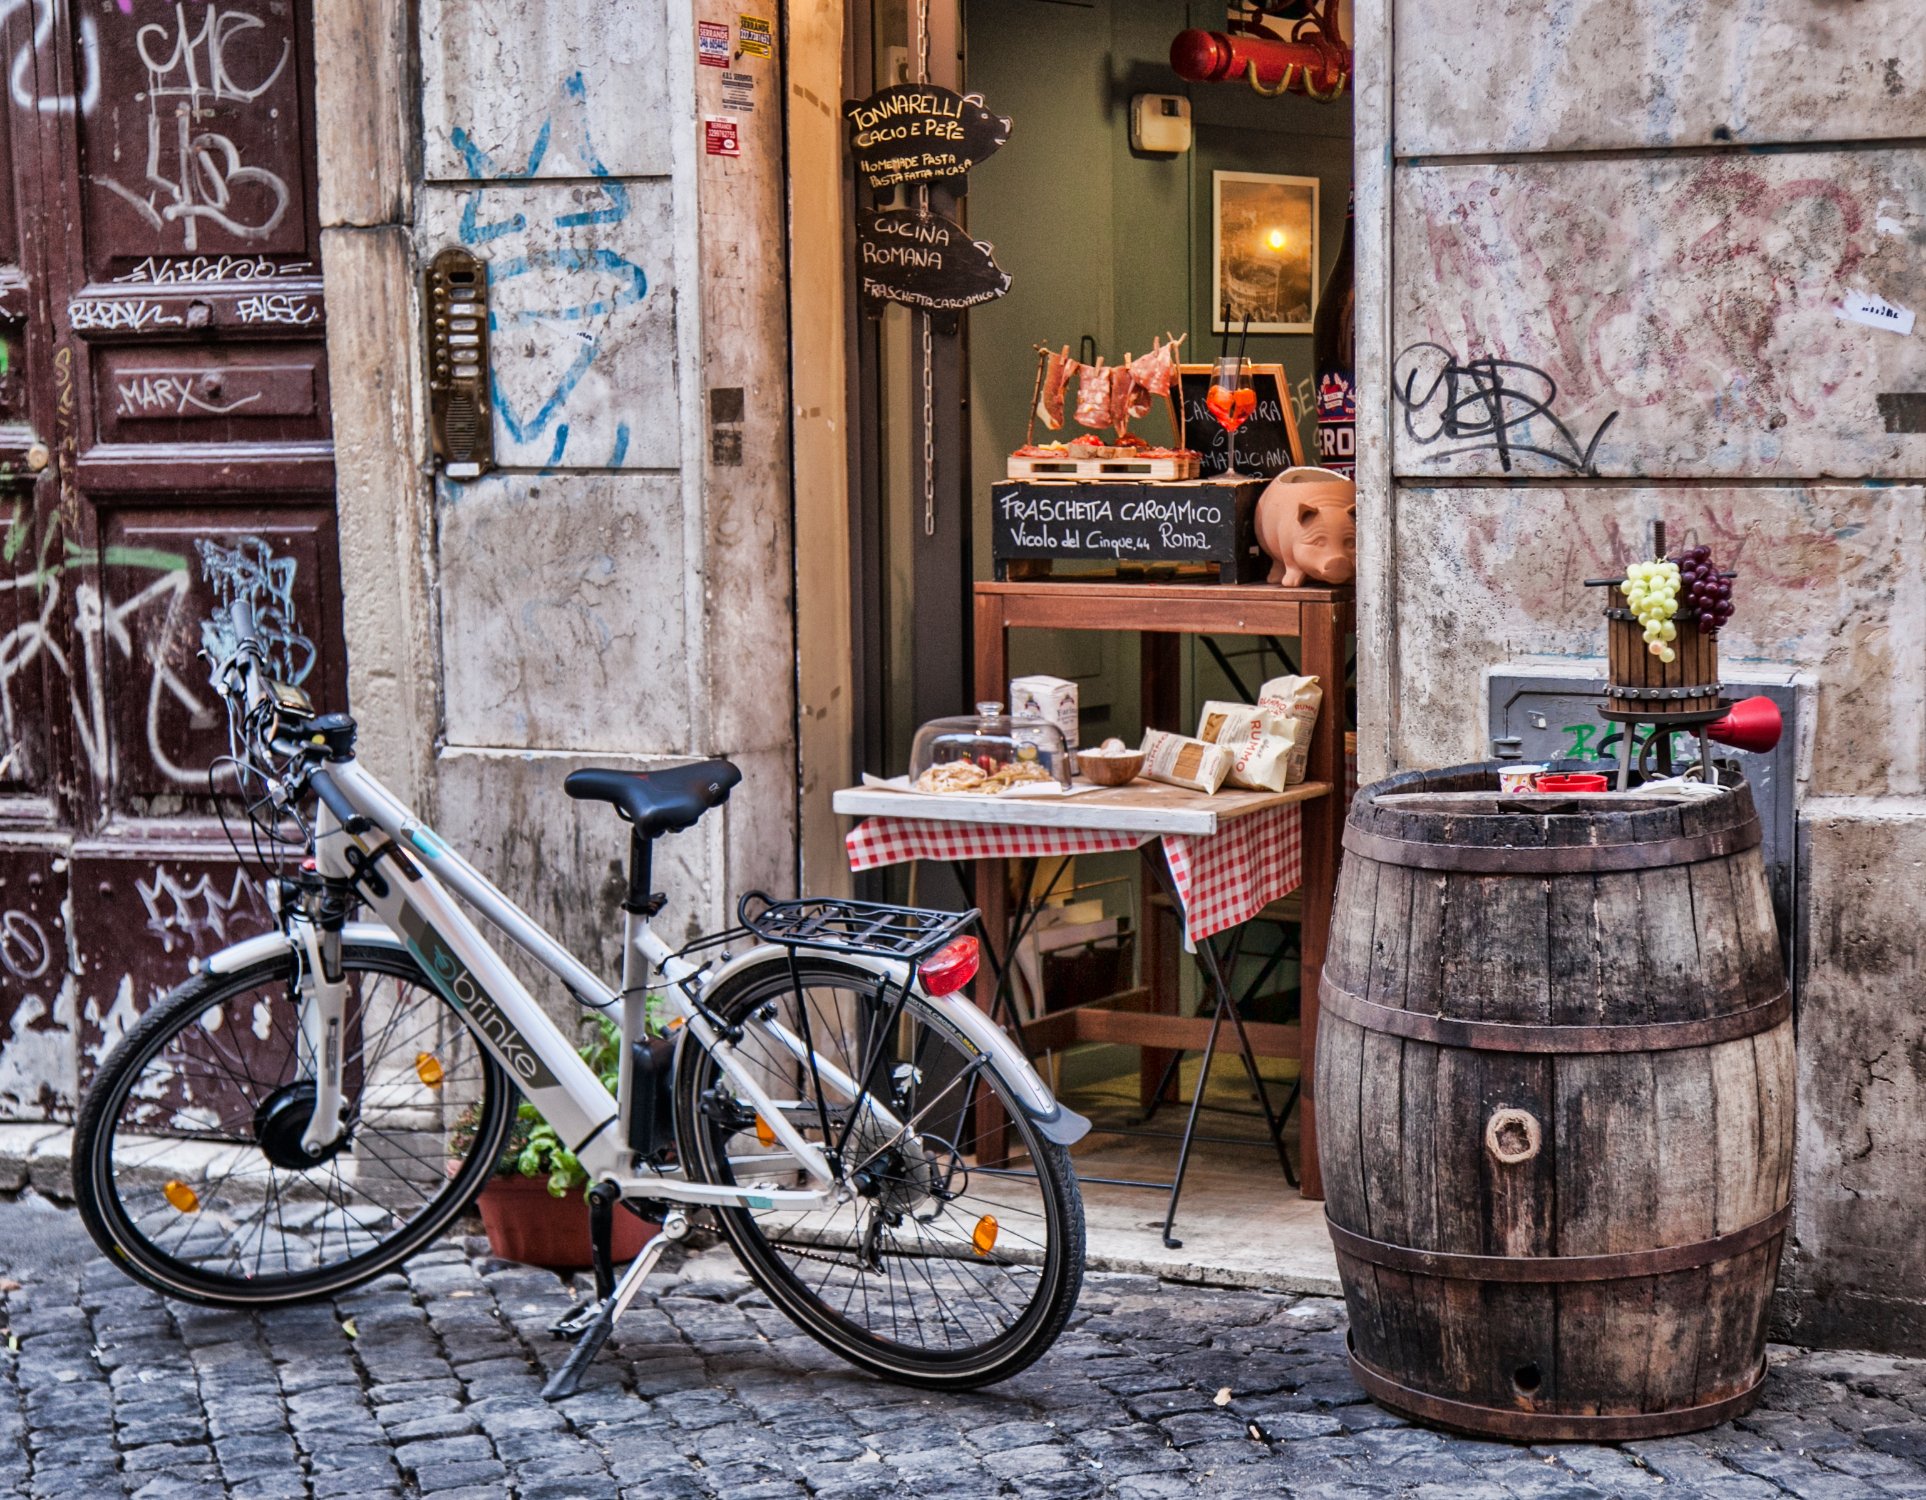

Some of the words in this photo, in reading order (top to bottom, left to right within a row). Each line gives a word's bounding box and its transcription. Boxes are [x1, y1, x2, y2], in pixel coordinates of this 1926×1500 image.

[700, 28, 729, 40] SERRANDE
[848, 94, 963, 131] TONNARELLI
[857, 126, 907, 147] CACIO
[911, 123, 921, 136] E
[925, 119, 965, 140] PEPE
[860, 156, 919, 172] HOMEMADE
[922, 153, 956, 166] PASTA
[946, 158, 972, 176] CASA
[874, 218, 949, 246] CUCINA
[863, 242, 942, 270] ROMANA
[1000, 491, 1113, 522] FRASCHETTA
[1120, 499, 1222, 524] CAROAMICO
[1010, 522, 1058, 549] Vicolo
[1061, 528, 1080, 549] del
[1235, 719, 1263, 773] RUMMO
[453, 969, 537, 1079] brinke
